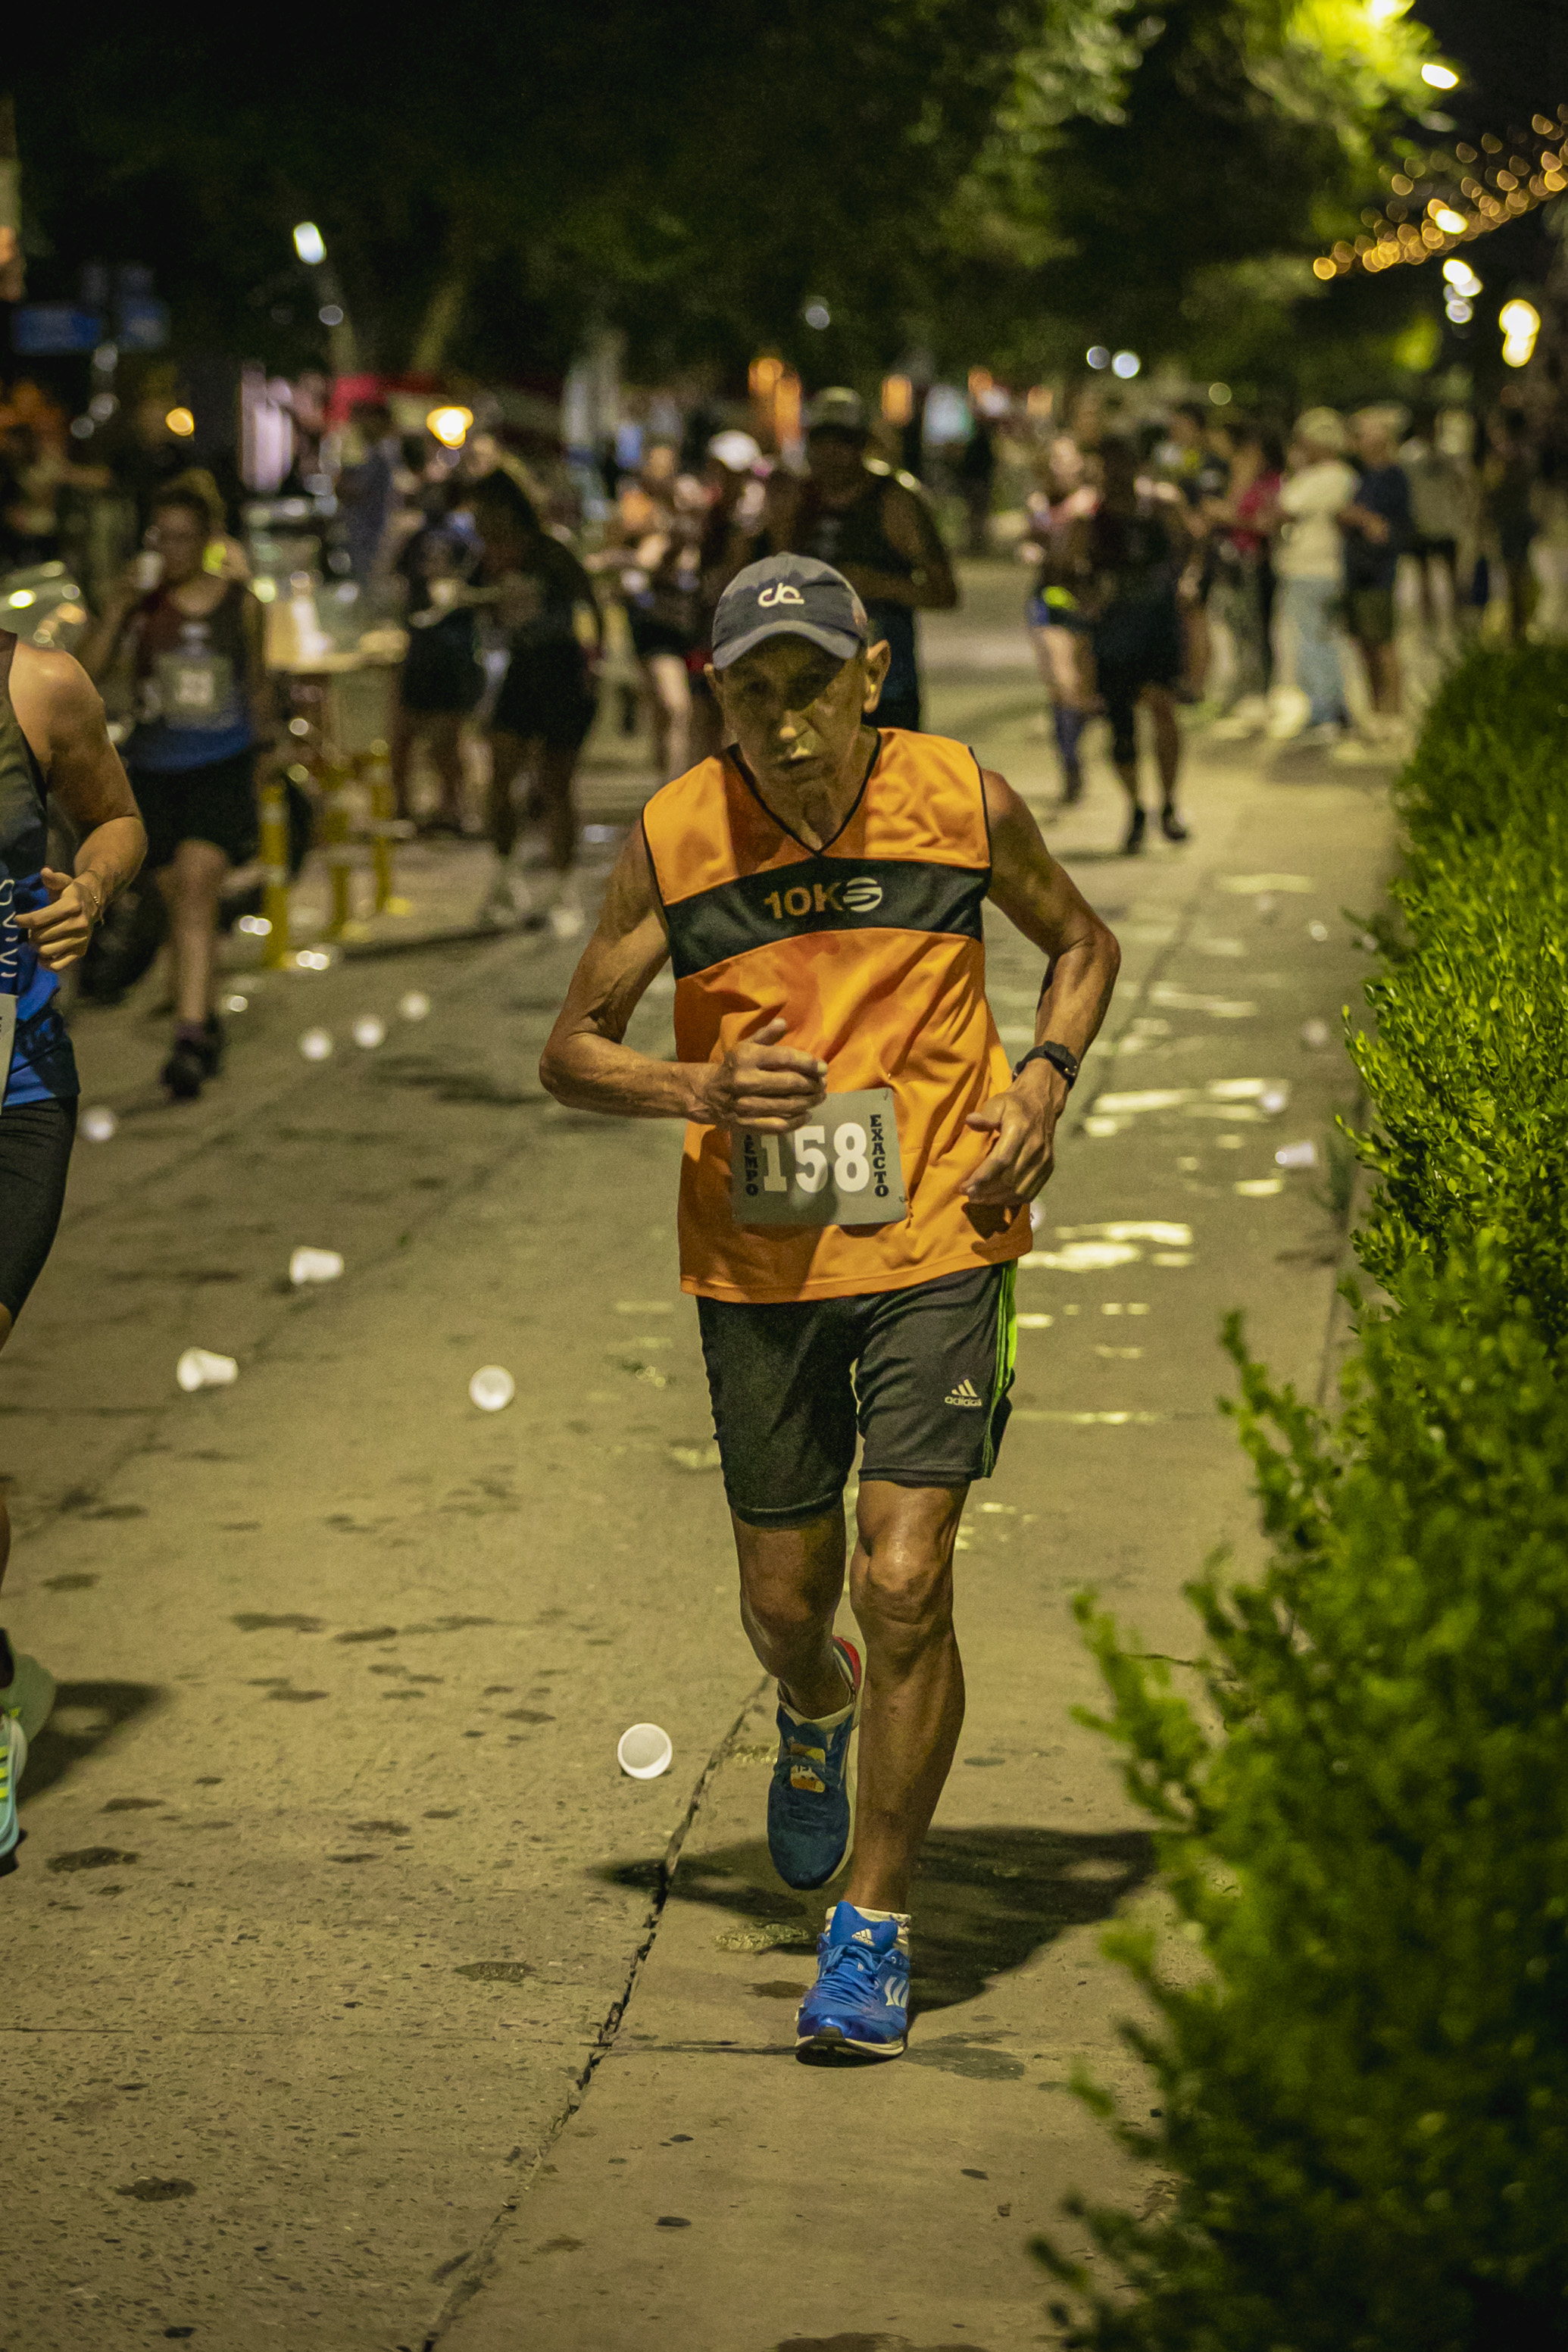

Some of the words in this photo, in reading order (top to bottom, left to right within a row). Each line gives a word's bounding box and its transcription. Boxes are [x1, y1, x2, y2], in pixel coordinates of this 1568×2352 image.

[764, 882, 843, 920] 10K
[761, 1122, 870, 1193] 158
[870, 1114, 889, 1198] EXACTO
[945, 1396, 982, 1407] adidas
